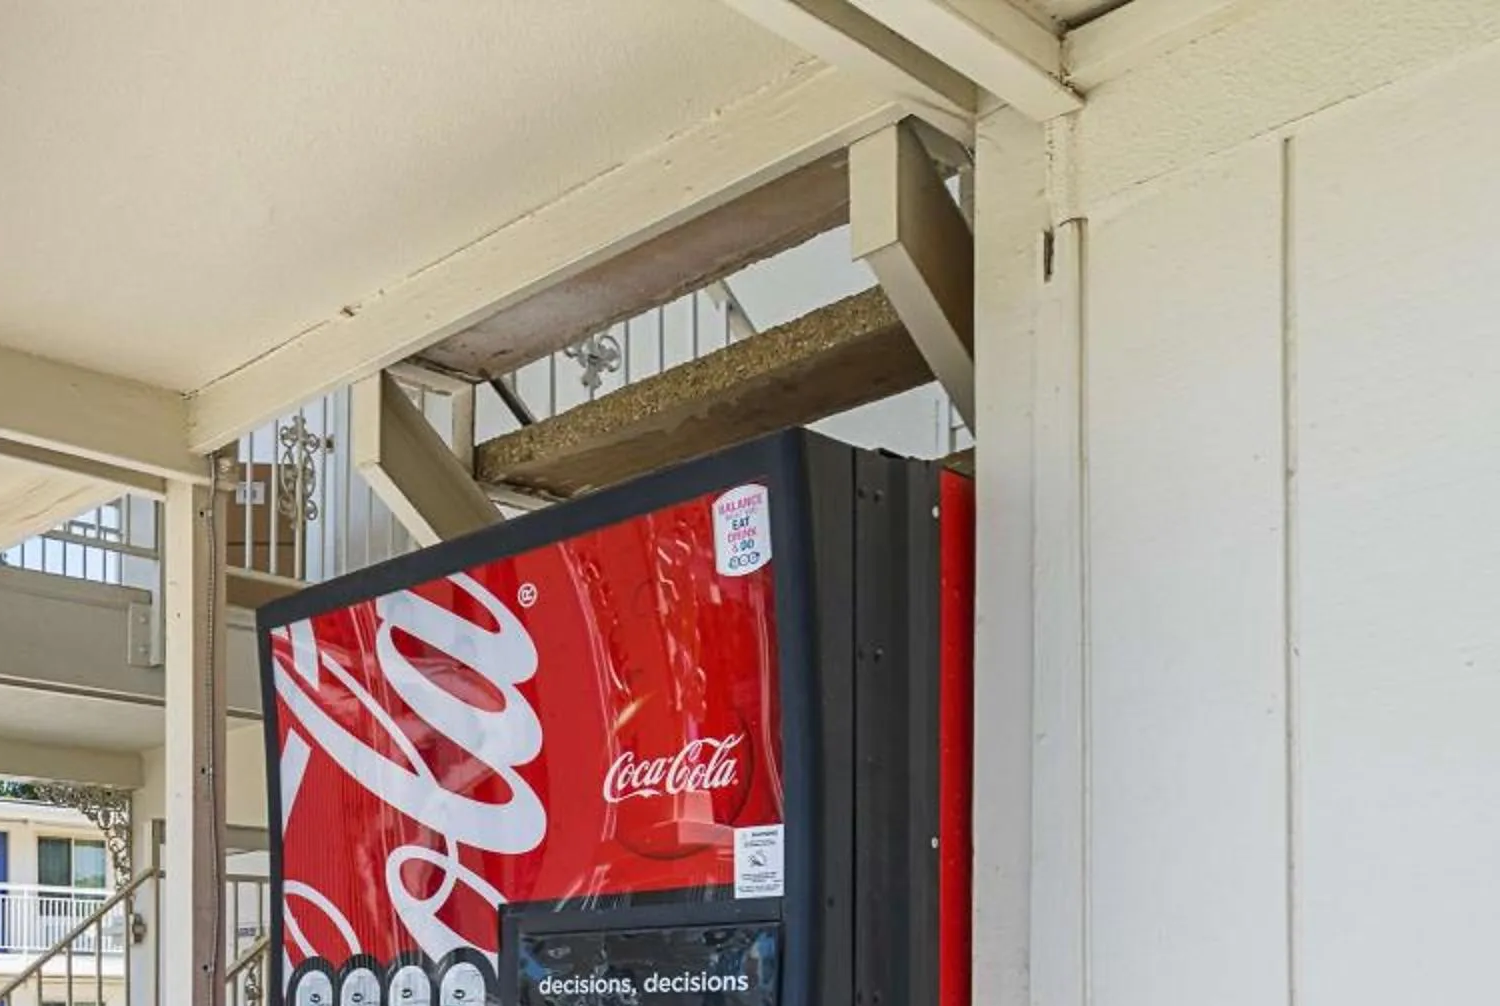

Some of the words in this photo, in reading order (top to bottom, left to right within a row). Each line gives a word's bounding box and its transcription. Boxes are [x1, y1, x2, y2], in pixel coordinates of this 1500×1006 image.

[731, 515, 750, 530] EAT
[603, 732, 745, 803] Coca-Cola
[539, 975, 637, 996] decisions,
[644, 971, 749, 993] decisions
